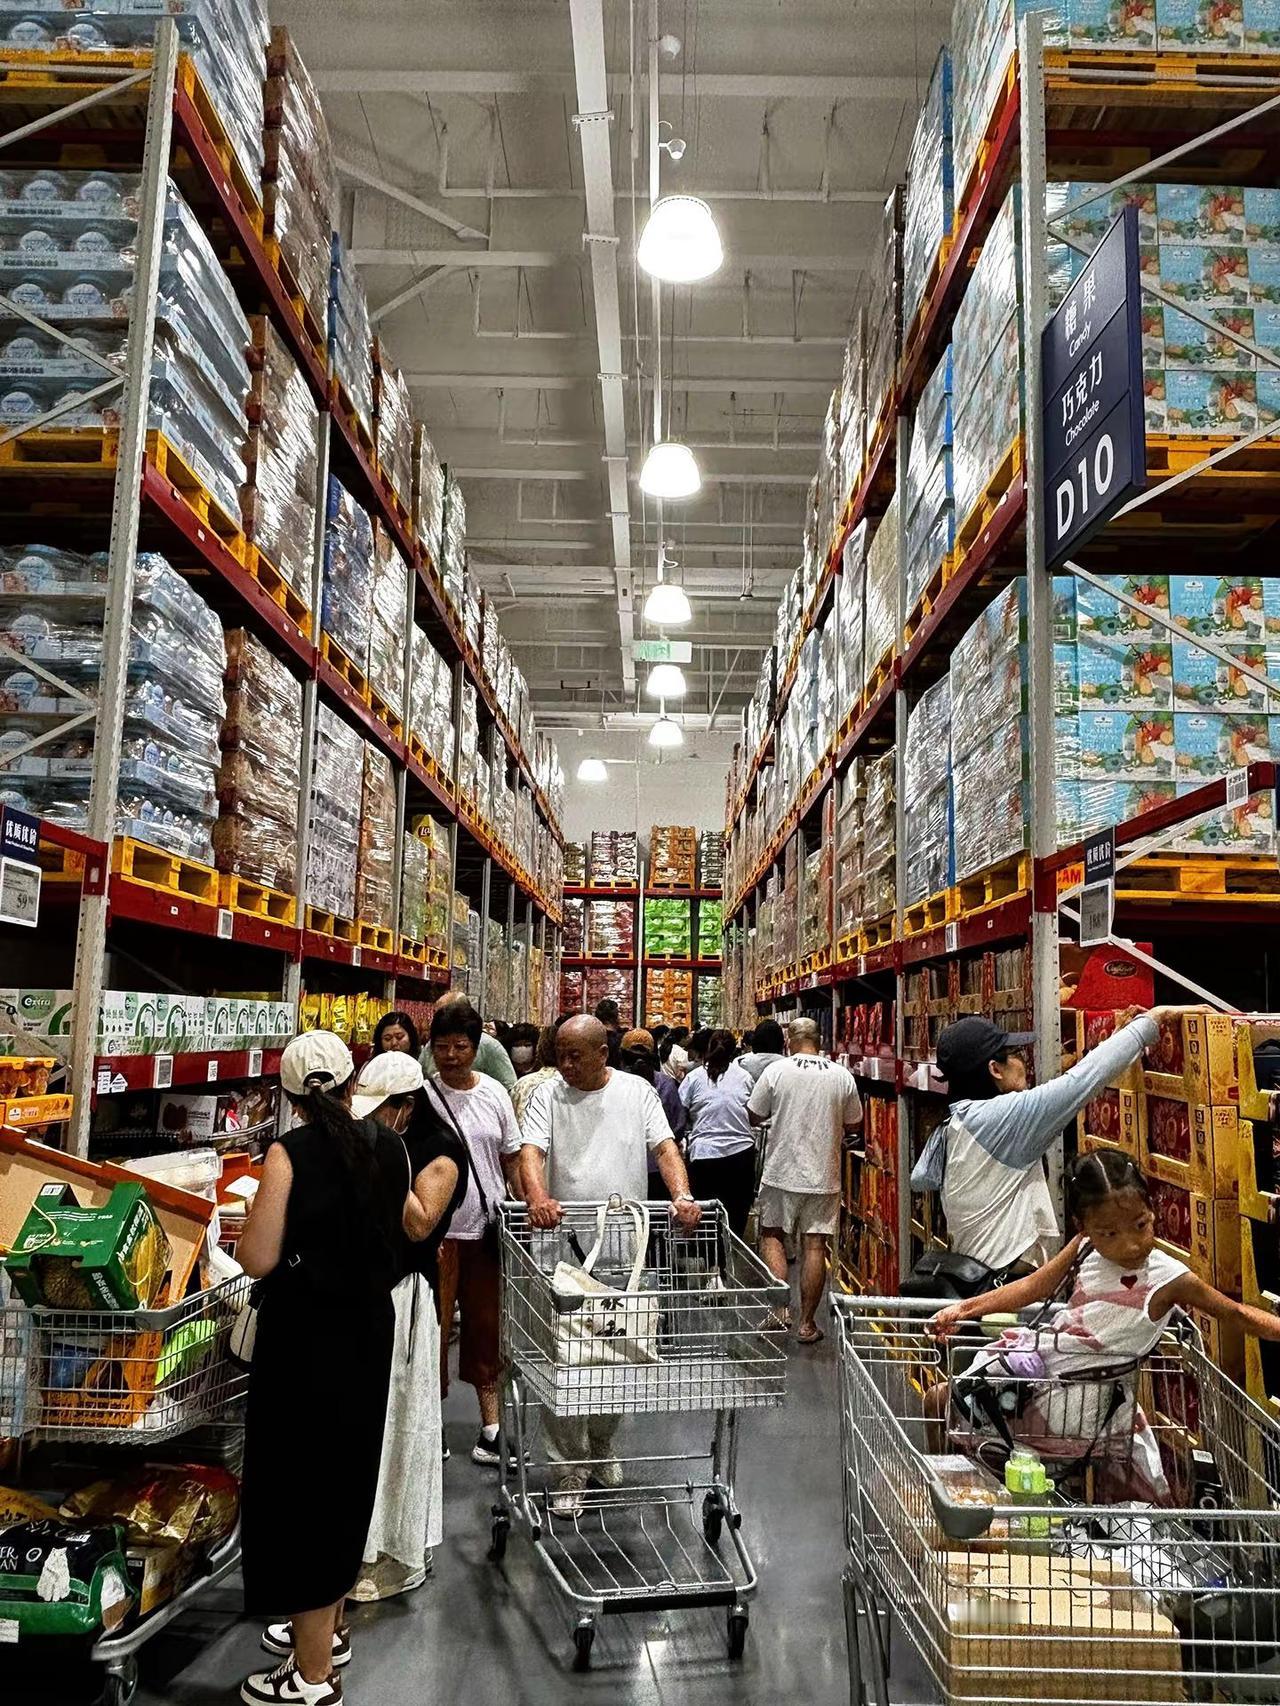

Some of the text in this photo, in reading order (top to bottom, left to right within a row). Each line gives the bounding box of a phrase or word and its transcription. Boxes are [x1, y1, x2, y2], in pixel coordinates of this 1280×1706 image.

[1064, 269, 1096, 341] 糖果
[1069, 320, 1092, 358] Candy
[1061, 350, 1103, 427] 巧克力
[1065, 398, 1100, 447] Chocolate
[1056, 433, 1114, 541] D10
[0, 1546, 18, 1560] ER
